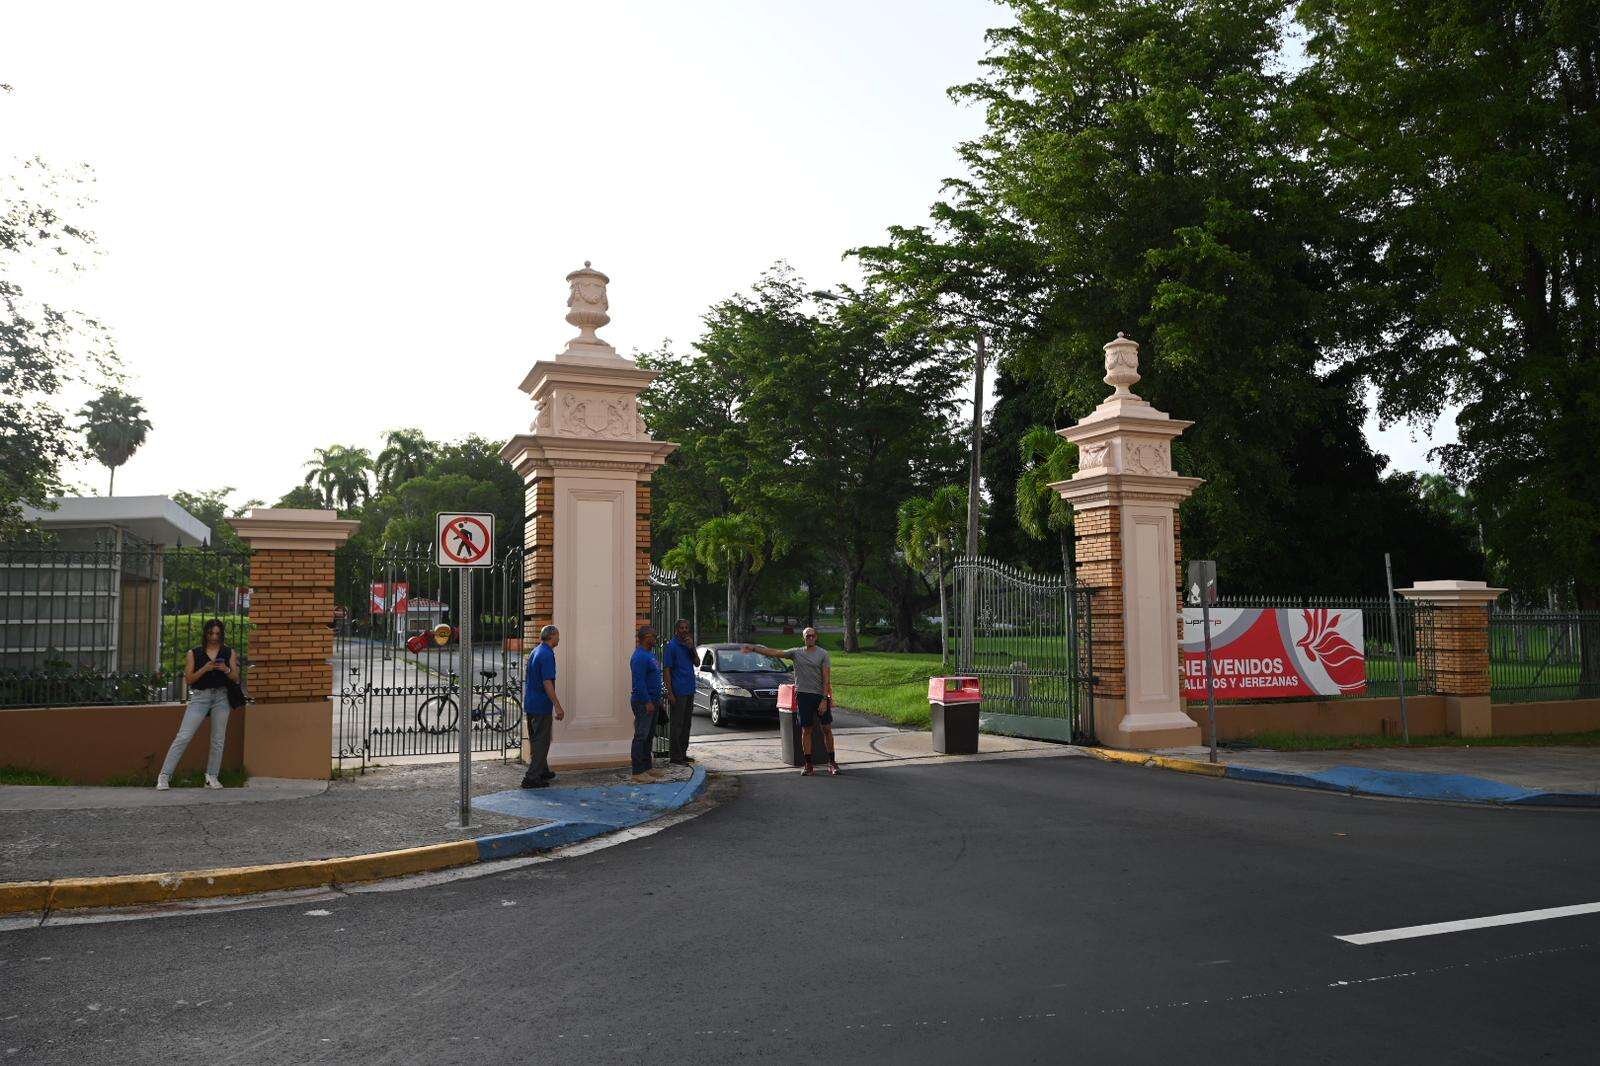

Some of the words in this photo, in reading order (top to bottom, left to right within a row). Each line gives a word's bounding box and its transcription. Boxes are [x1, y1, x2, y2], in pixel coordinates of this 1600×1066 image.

[1185, 658, 1284, 676] IEVENIDOS
[1184, 677, 1228, 690] ALLIOS
[1229, 677, 1237, 688] Y
[1239, 675, 1299, 688] JEREZANAS
